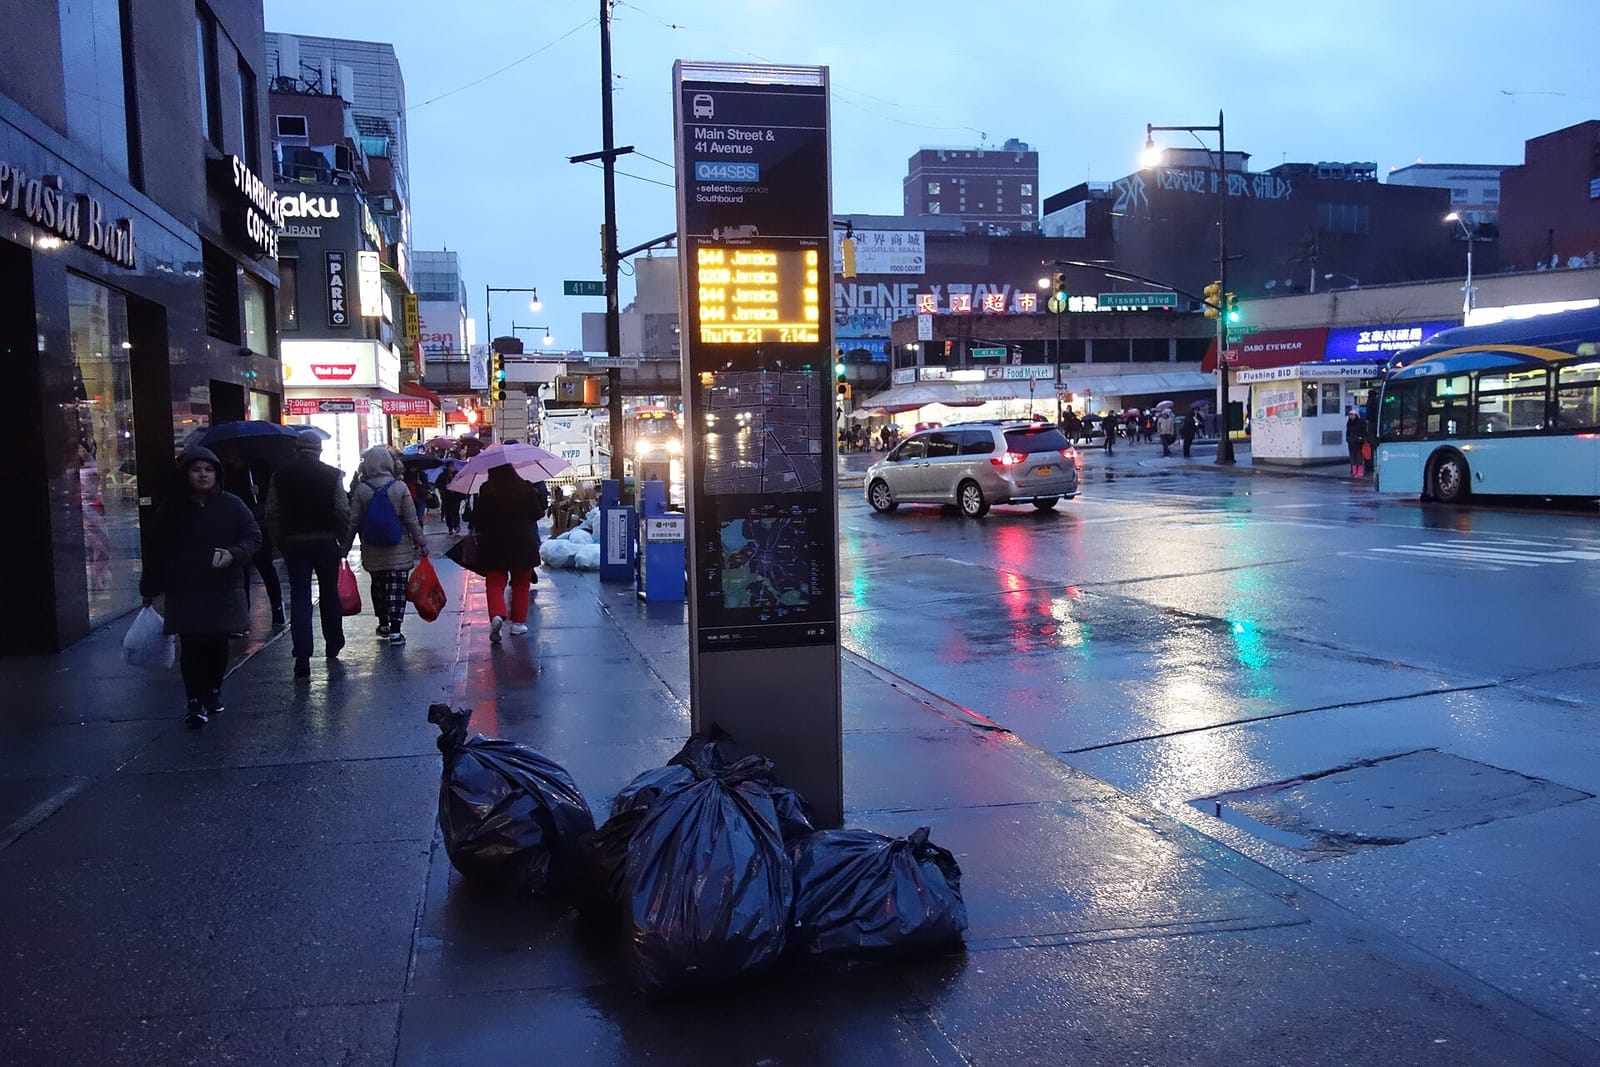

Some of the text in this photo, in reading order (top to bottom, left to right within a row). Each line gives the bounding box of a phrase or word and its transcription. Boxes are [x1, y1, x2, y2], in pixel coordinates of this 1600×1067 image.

[695, 128, 775, 141] Main Street &
[695, 142, 753, 154] 41 Avenue
[699, 165, 756, 179] Q44SBS
[232, 154, 285, 229] STARBUCKS
[696, 194, 743, 203] Southbound
[0, 160, 136, 267] erasia Bank
[246, 207, 279, 262] COFFEE
[730, 249, 777, 266] Jamaica
[890, 265, 922, 273] FOOD COURT
[731, 268, 778, 284] Jamaica
[331, 263, 345, 312] PARK
[573, 283, 584, 295] 41
[699, 287, 726, 303] Q44
[731, 287, 778, 303] Jamaica
[835, 283, 919, 308] NONE
[1108, 295, 1170, 304] Kissena Blvd
[917, 294, 1036, 313] 長江超市
[699, 305, 726, 321] Q44
[732, 305, 779, 321] Jamaica
[1266, 342, 1302, 351] EYEWEAR
[1007, 369, 1025, 378] Food
[1026, 368, 1048, 378] Market
[1243, 368, 1292, 381] Flushing BID
[1301, 370, 1311, 378] NYC
[1341, 368, 1361, 377] Peter
[1363, 367, 1378, 377] Koo
[289, 400, 316, 408] 7:00am
[561, 450, 580, 459] NYPD
